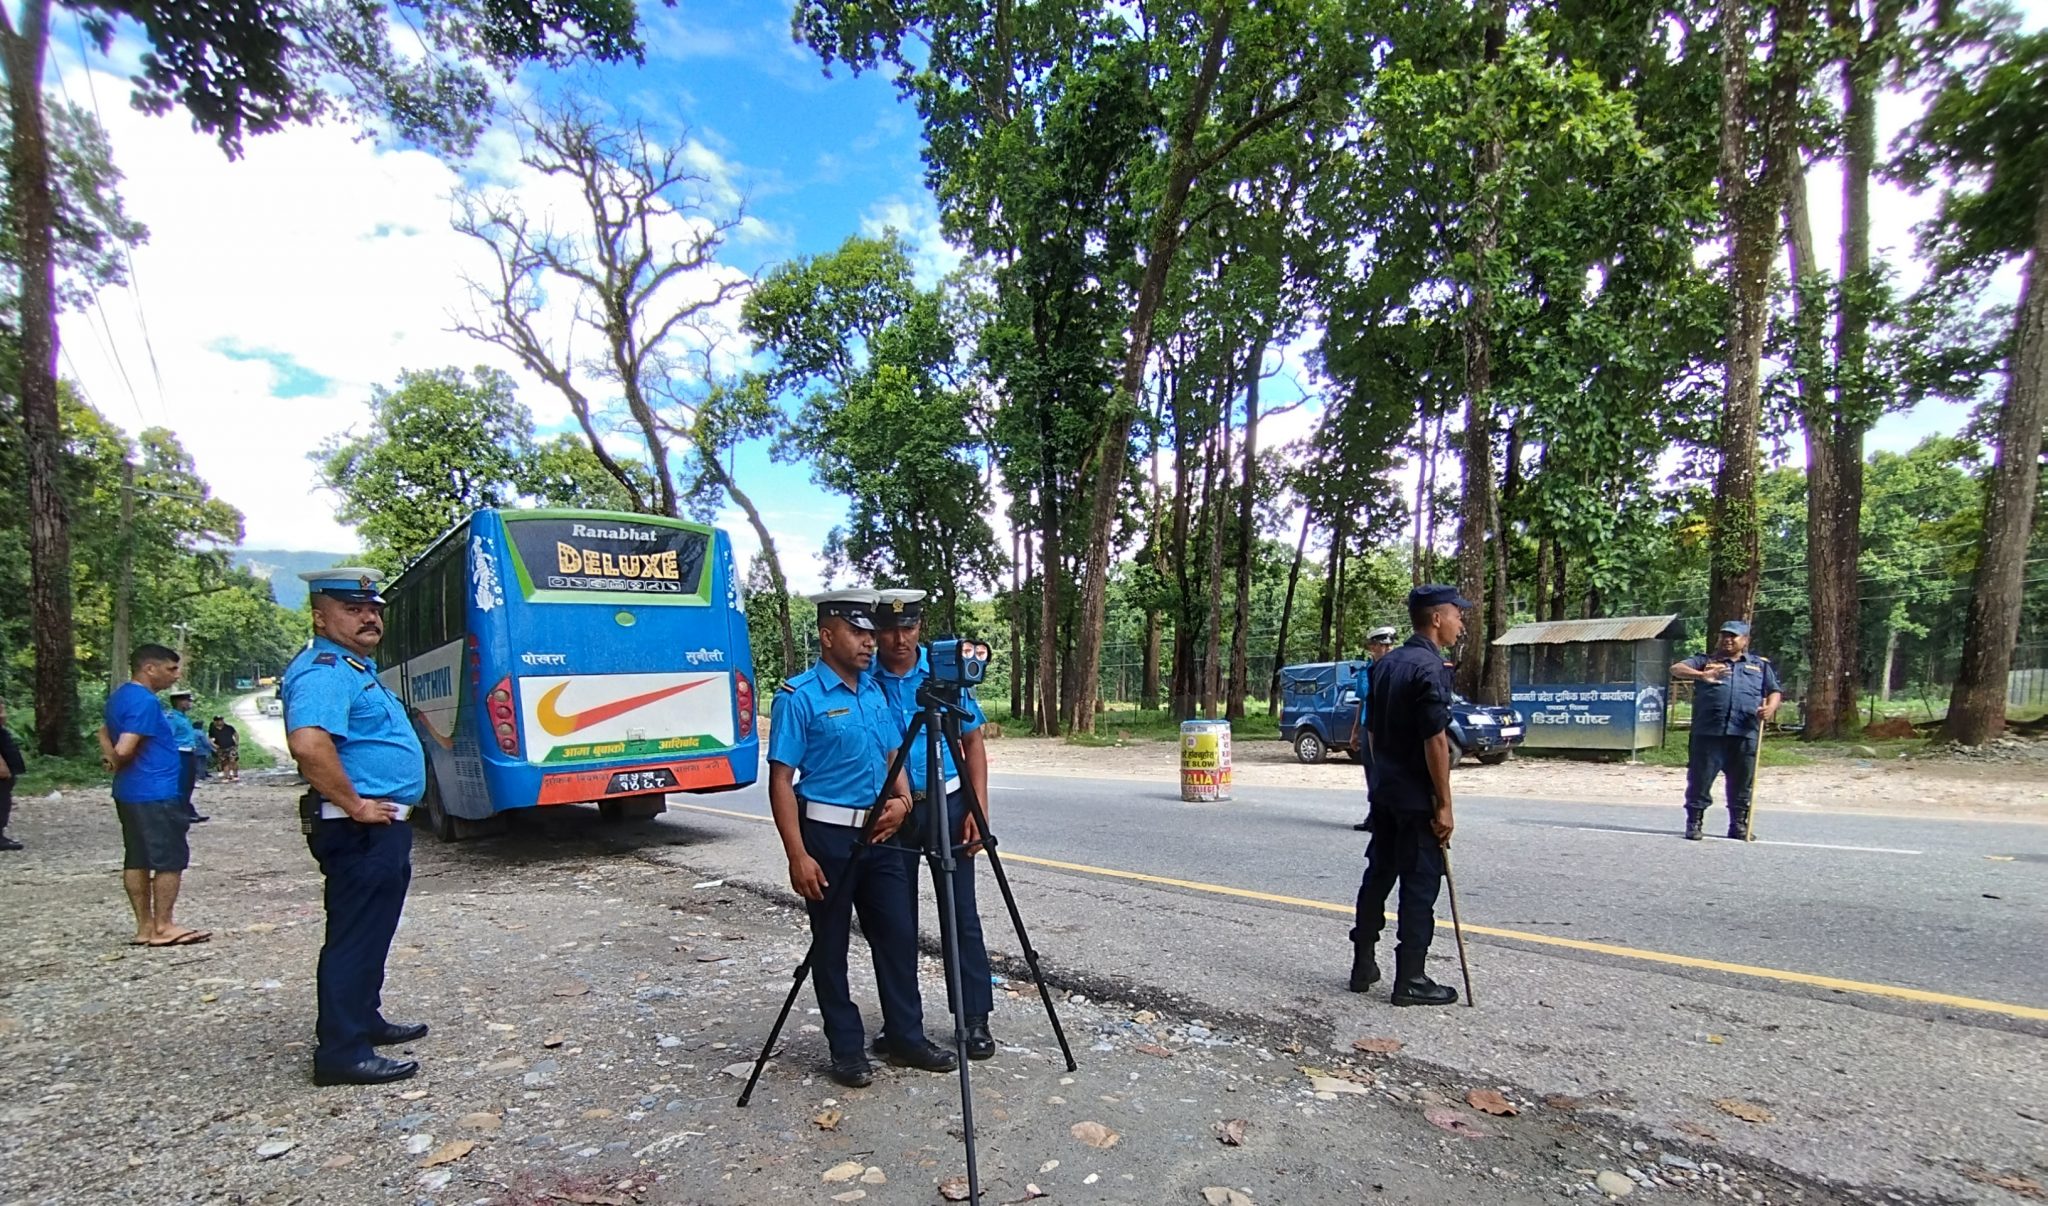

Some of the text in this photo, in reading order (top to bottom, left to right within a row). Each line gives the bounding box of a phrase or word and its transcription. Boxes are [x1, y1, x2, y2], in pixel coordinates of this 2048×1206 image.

[571, 524, 657, 542] Ranabhat
[557, 541, 680, 580] DELUXE
[520, 651, 567, 665] पोखरा
[1531, 711, 1571, 725] डिउटी
[562, 746, 590, 758] आमा
[1192, 760, 1215, 768] SLOW
